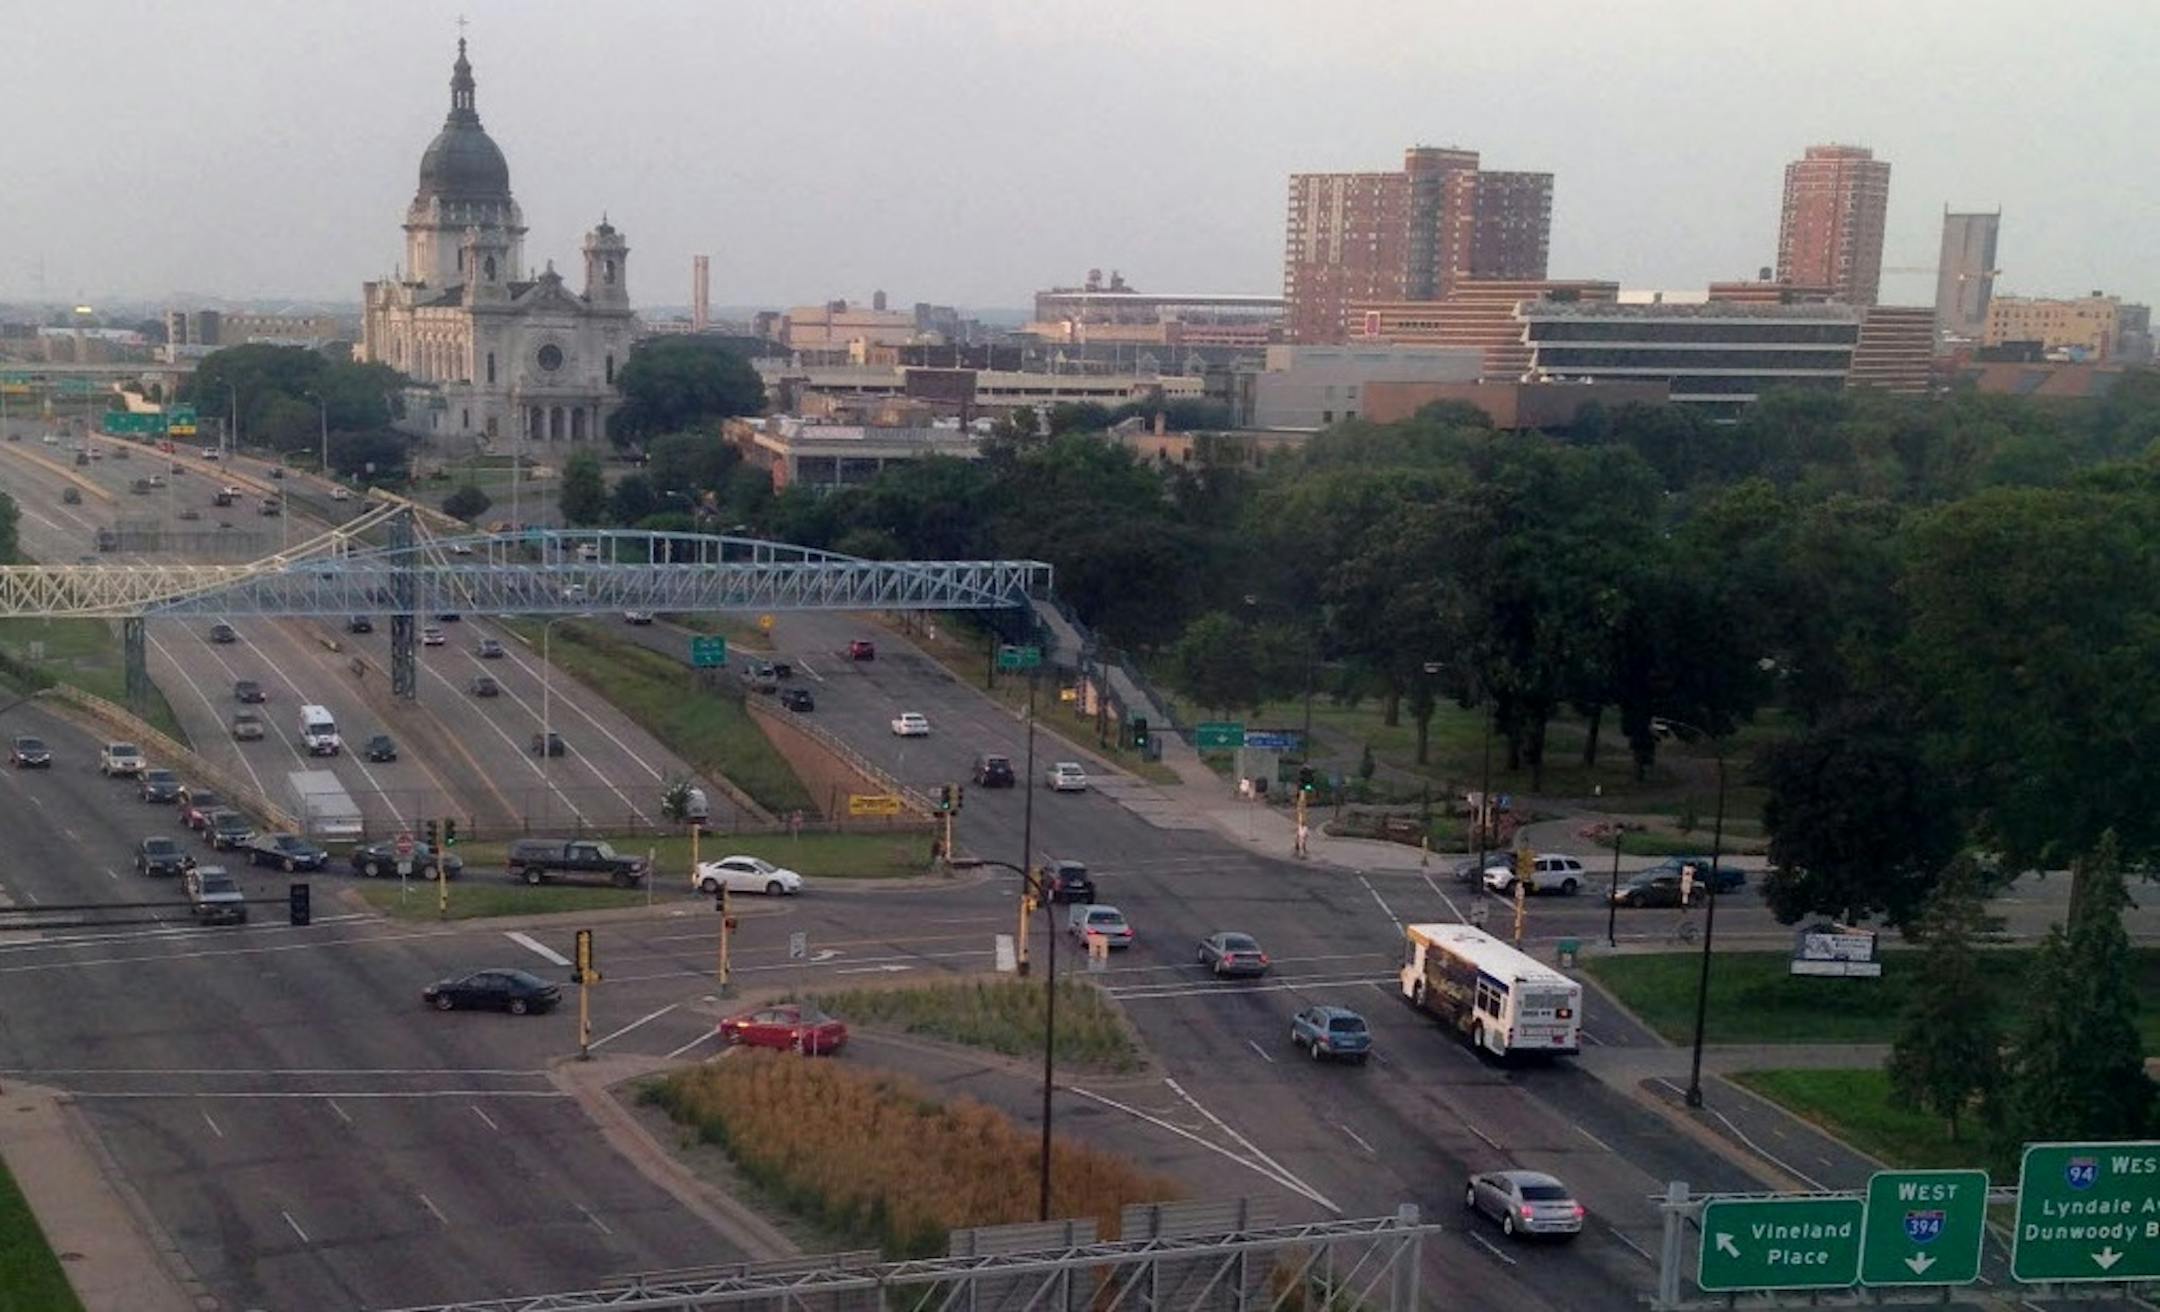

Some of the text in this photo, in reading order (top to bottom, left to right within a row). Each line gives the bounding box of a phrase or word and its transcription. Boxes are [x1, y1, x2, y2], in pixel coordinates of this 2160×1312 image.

[2070, 1166, 2094, 1182] 94
[1898, 1182, 1959, 1201] WEST
[2043, 1198, 2132, 1219] Lyndale
[1751, 1221, 1851, 1239] Vineland
[1909, 1219, 1939, 1235] 394
[2025, 1223, 2138, 1242] Dunwoody
[1767, 1249, 1829, 1265] Place
